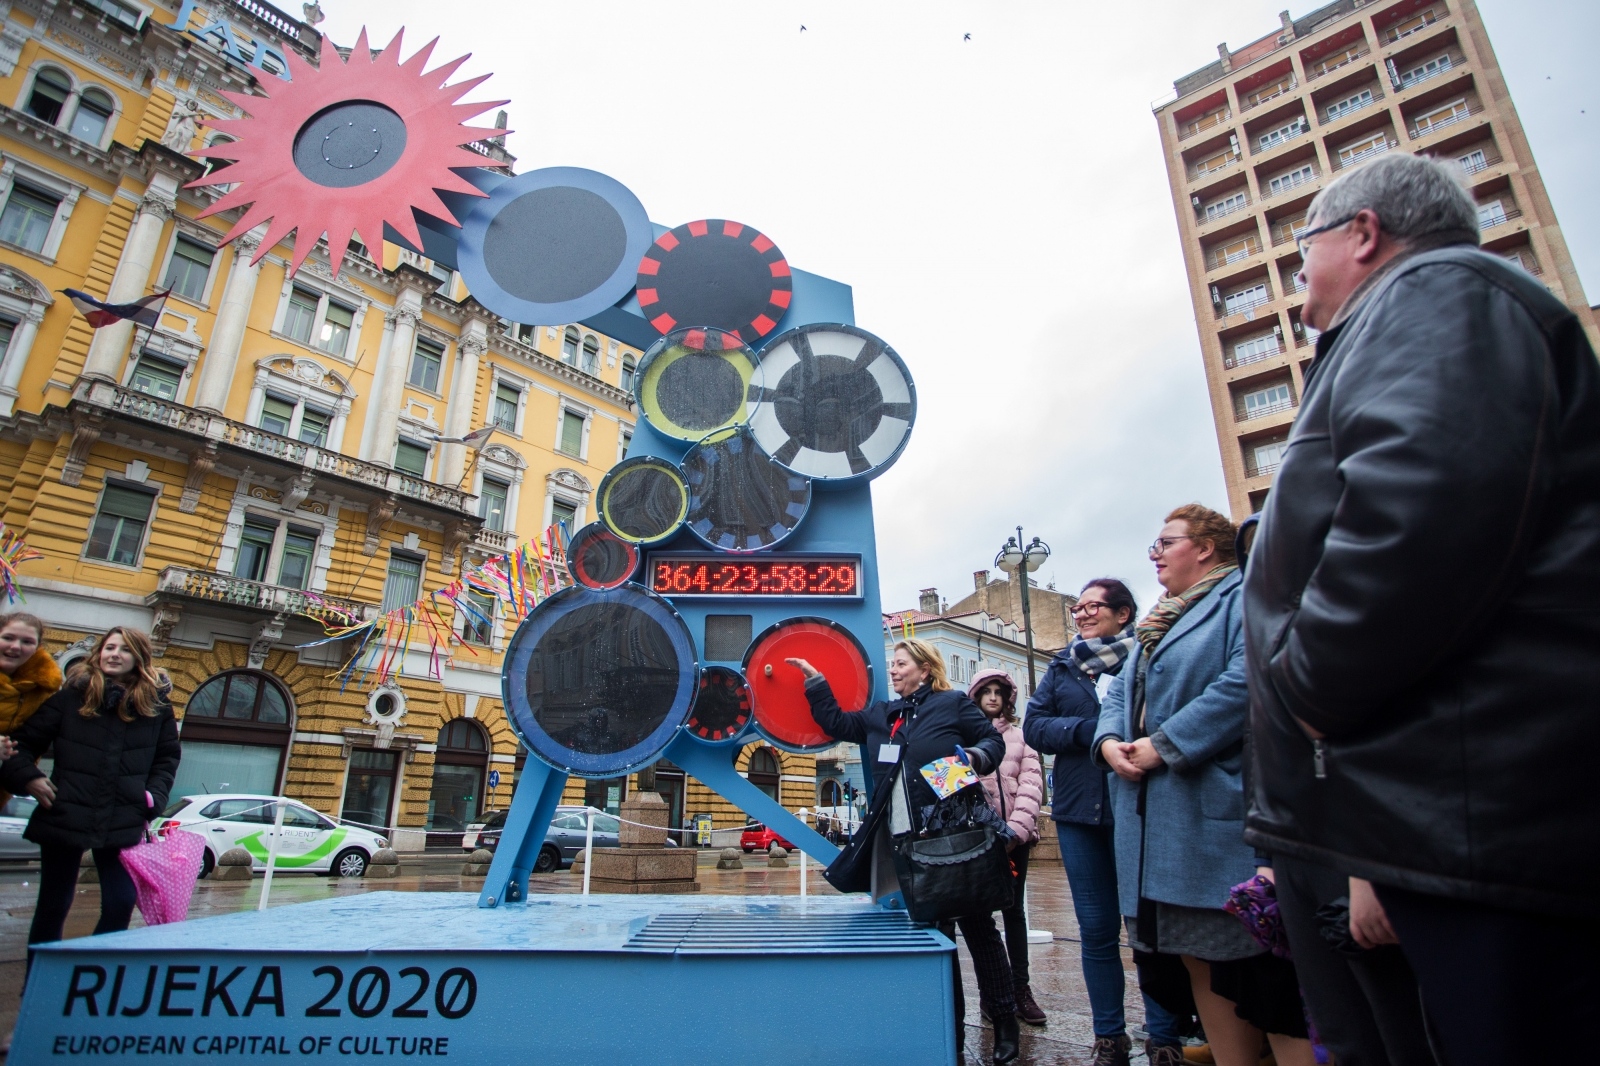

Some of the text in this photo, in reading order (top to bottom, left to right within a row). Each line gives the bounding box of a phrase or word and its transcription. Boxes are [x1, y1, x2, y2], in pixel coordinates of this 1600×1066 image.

[654, 565, 854, 592] 364:23:58:29
[284, 829, 317, 838] RIDENT
[62, 964, 478, 1020] RIJEKA 2020
[52, 1035, 449, 1056] EUROPEAN CAPITAL OF CULTURE
